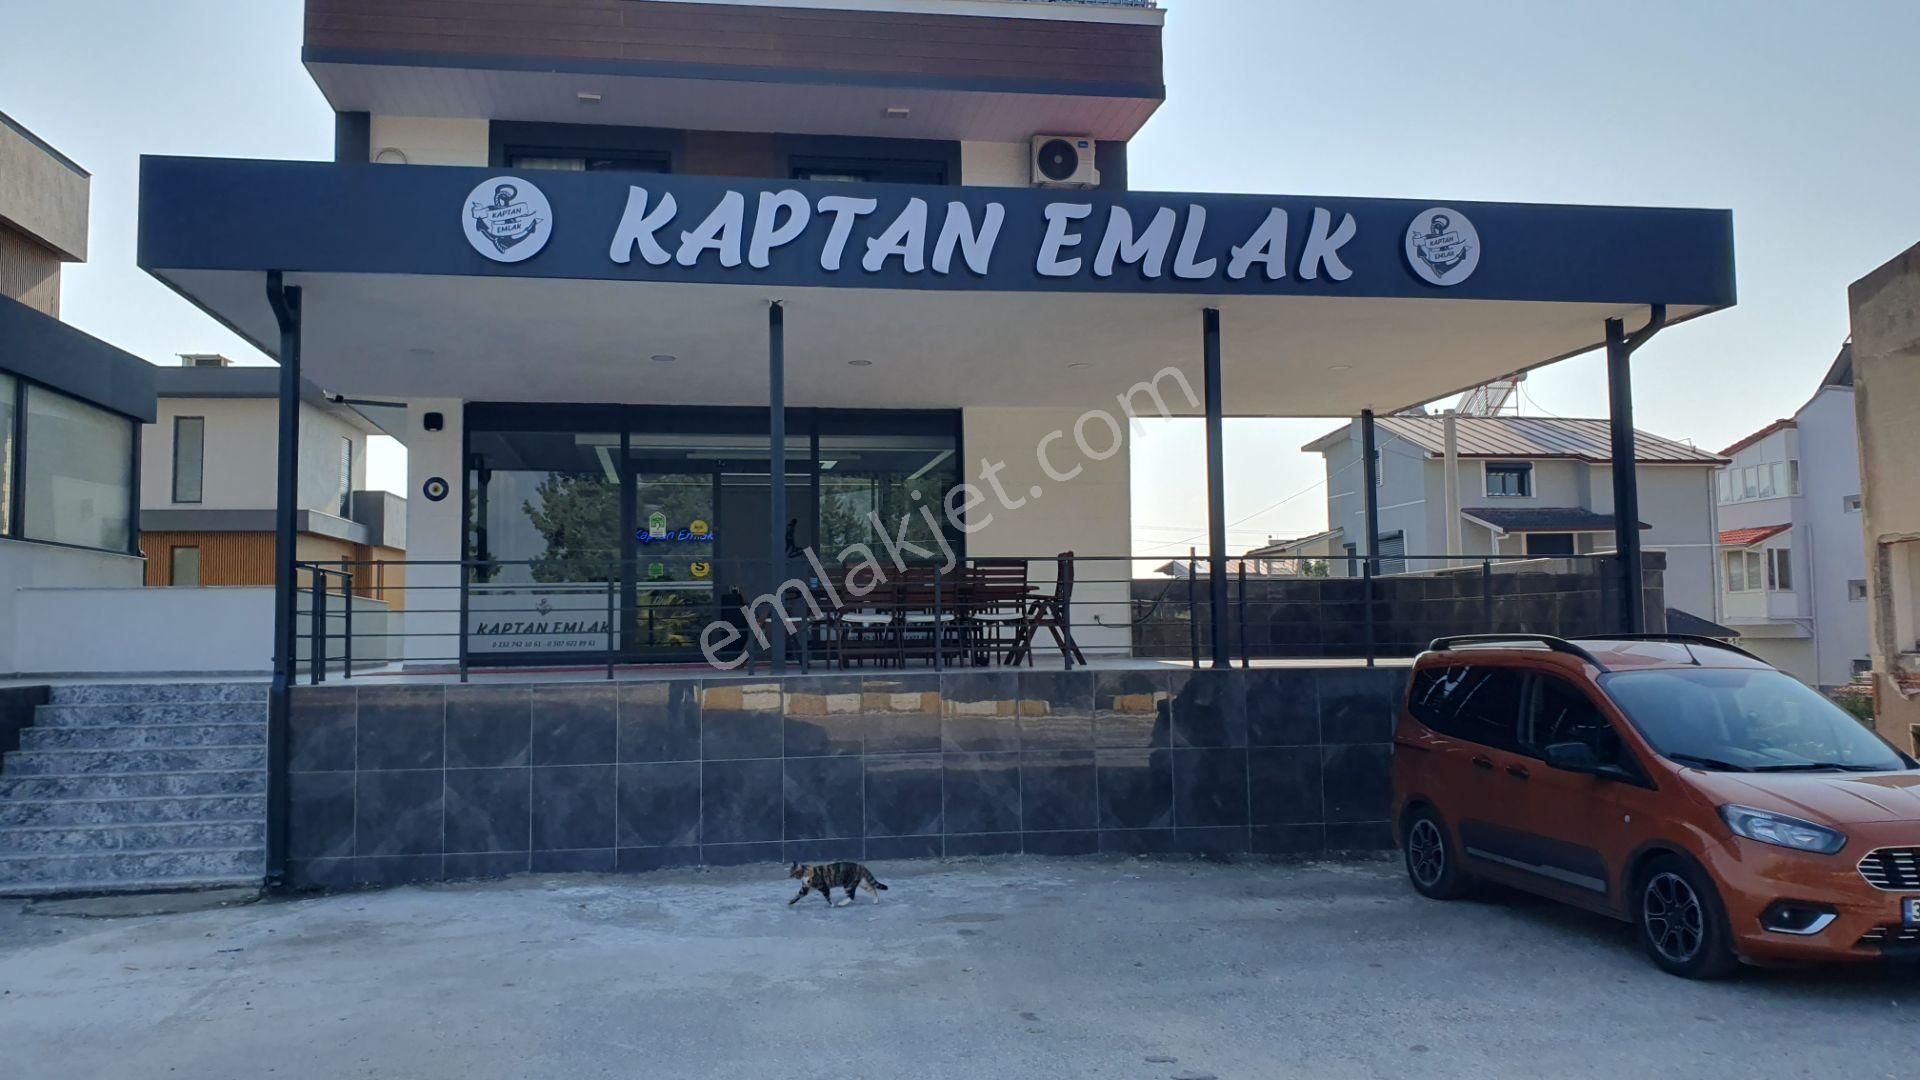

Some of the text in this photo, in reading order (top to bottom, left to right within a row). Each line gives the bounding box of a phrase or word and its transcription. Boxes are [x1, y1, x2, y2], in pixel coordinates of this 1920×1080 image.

[492, 207, 522, 219] KAPTAN
[497, 223, 522, 234] EMLAK
[609, 185, 1357, 281] KAPTAN EMLAK
[1430, 236, 1454, 247] KAPTAN
[1434, 250, 1455, 260] EMLAK
[477, 622, 547, 635] KAPTAN
